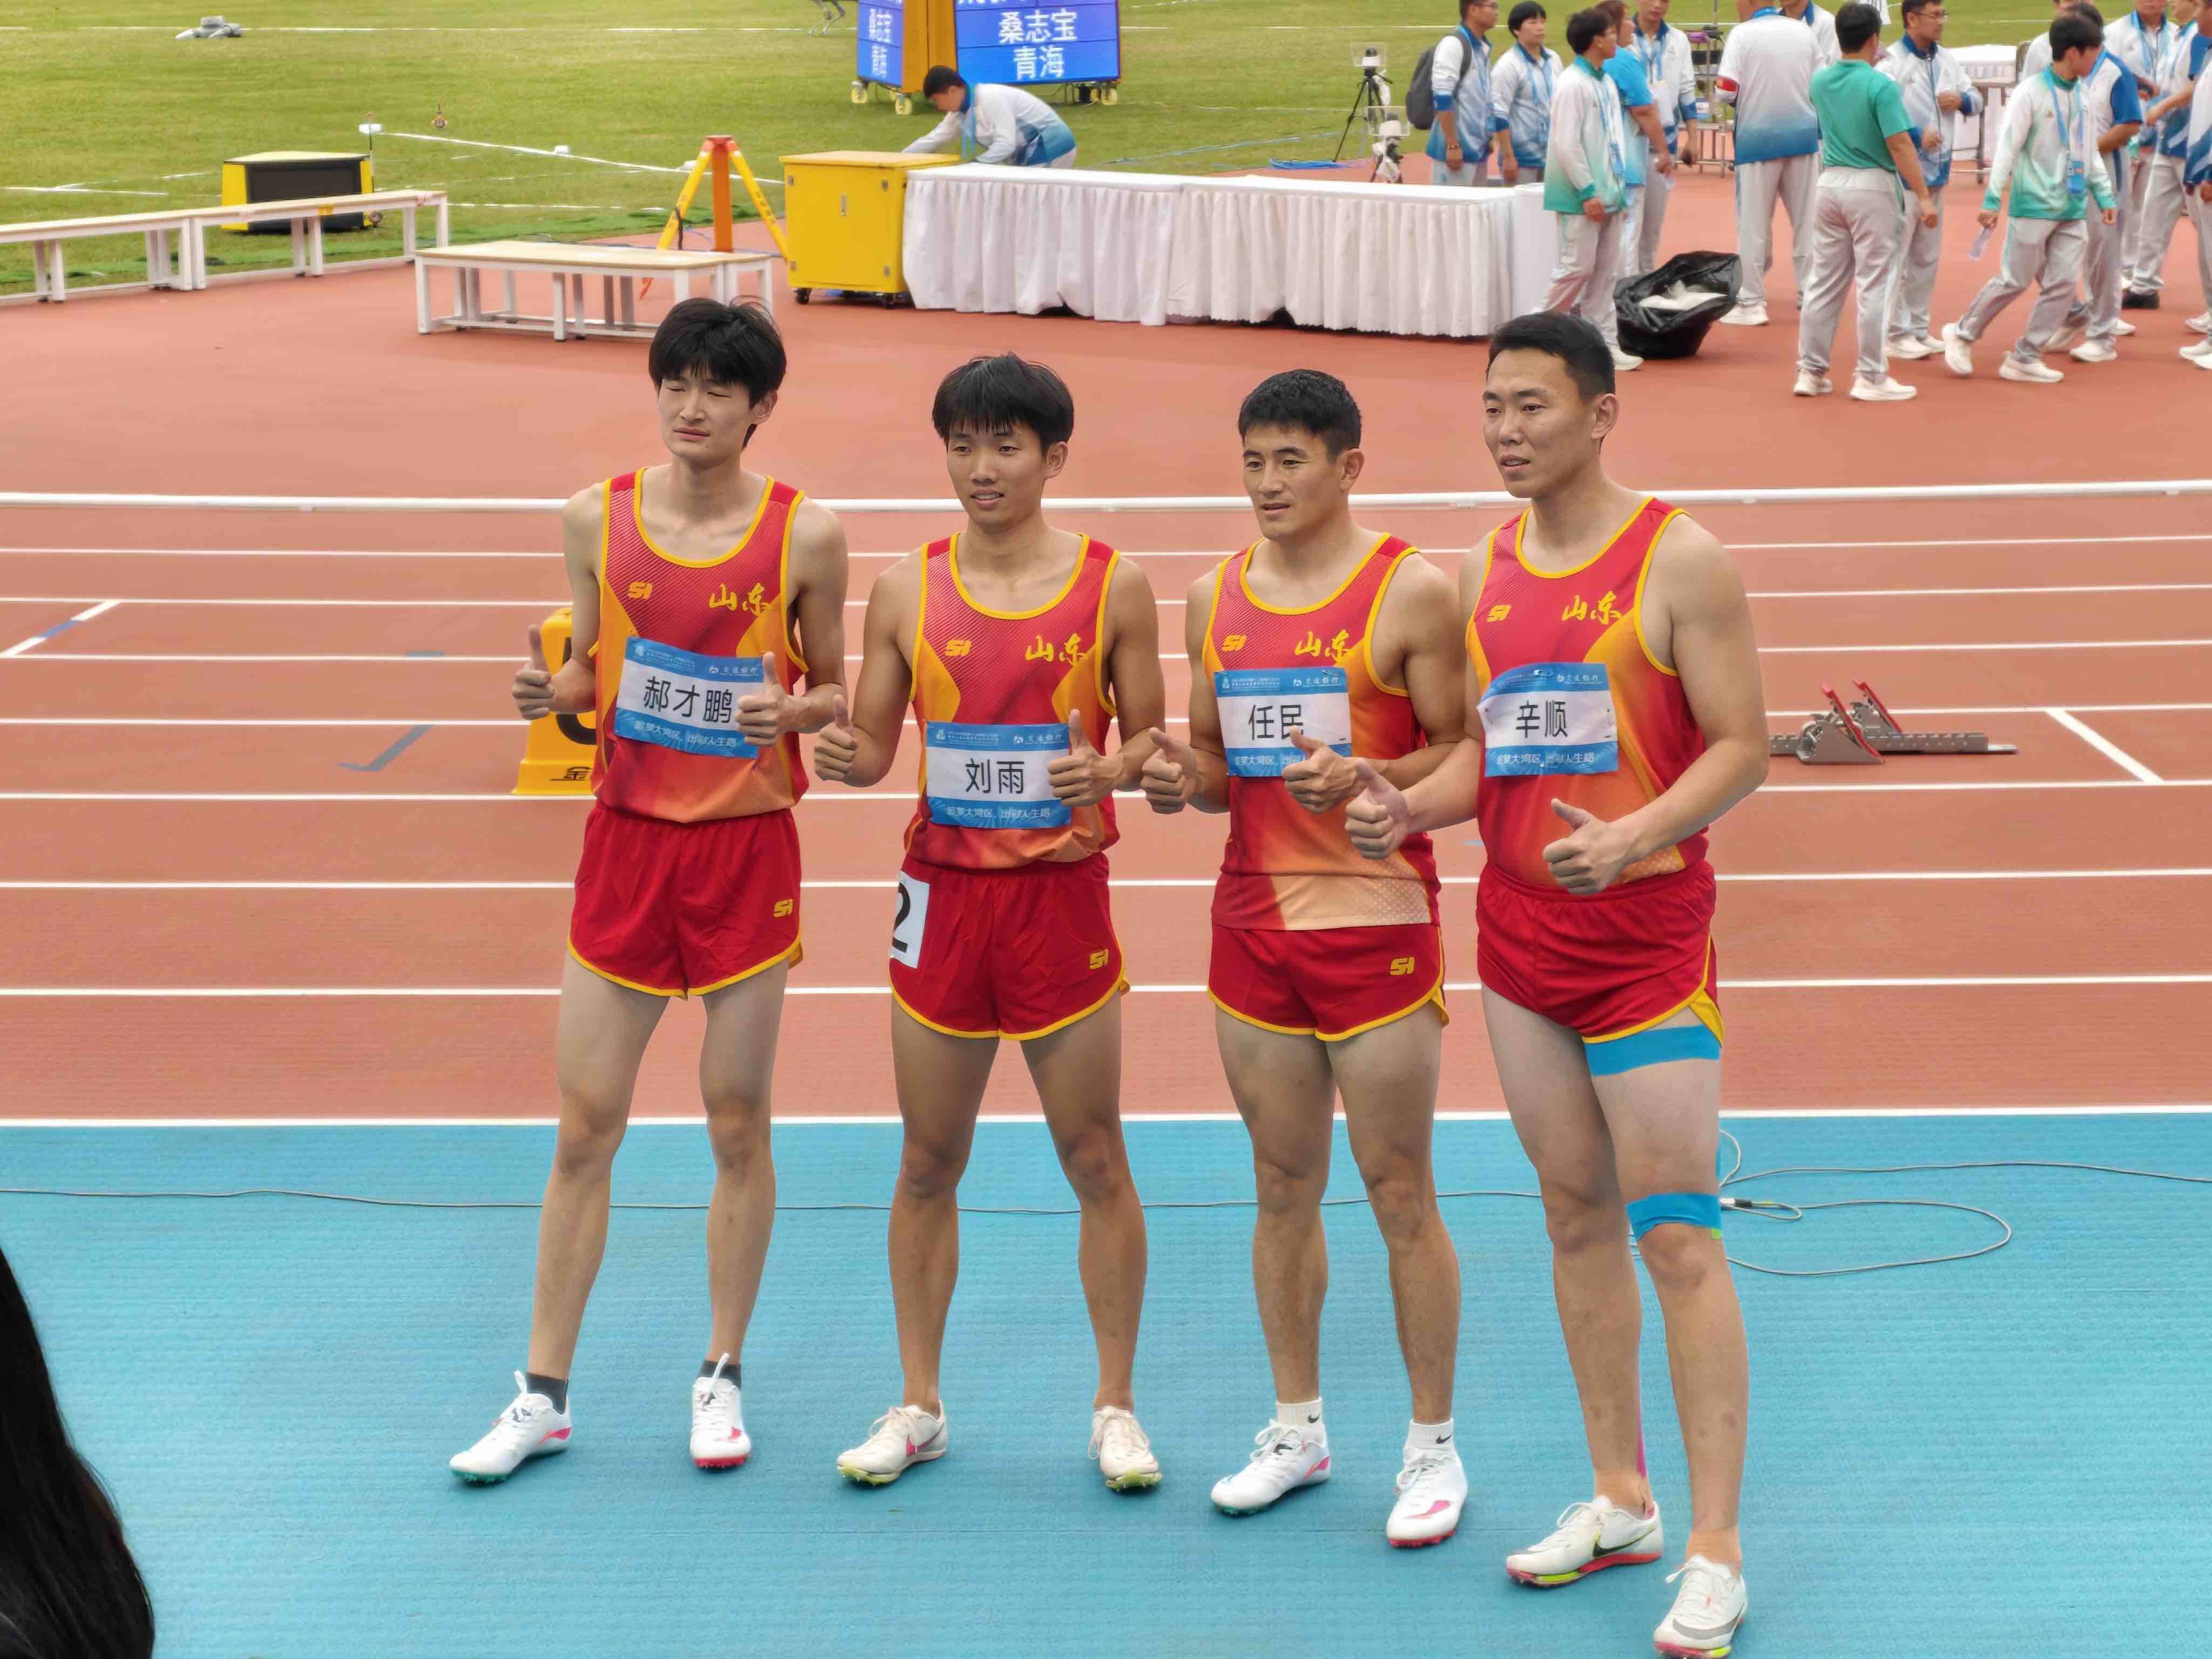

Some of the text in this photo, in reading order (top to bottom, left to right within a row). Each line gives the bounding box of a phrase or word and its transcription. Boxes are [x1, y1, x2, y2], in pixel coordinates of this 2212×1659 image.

[999, 8, 1077, 43] 桑志宝
[1014, 44, 1064, 79] 青海
[643, 676, 732, 723] 郝才鹏
[1248, 704, 1304, 740] 任民
[1515, 700, 1568, 738] 辛顺
[965, 758, 1024, 794] 刘雨
[892, 881, 911, 954] 2
